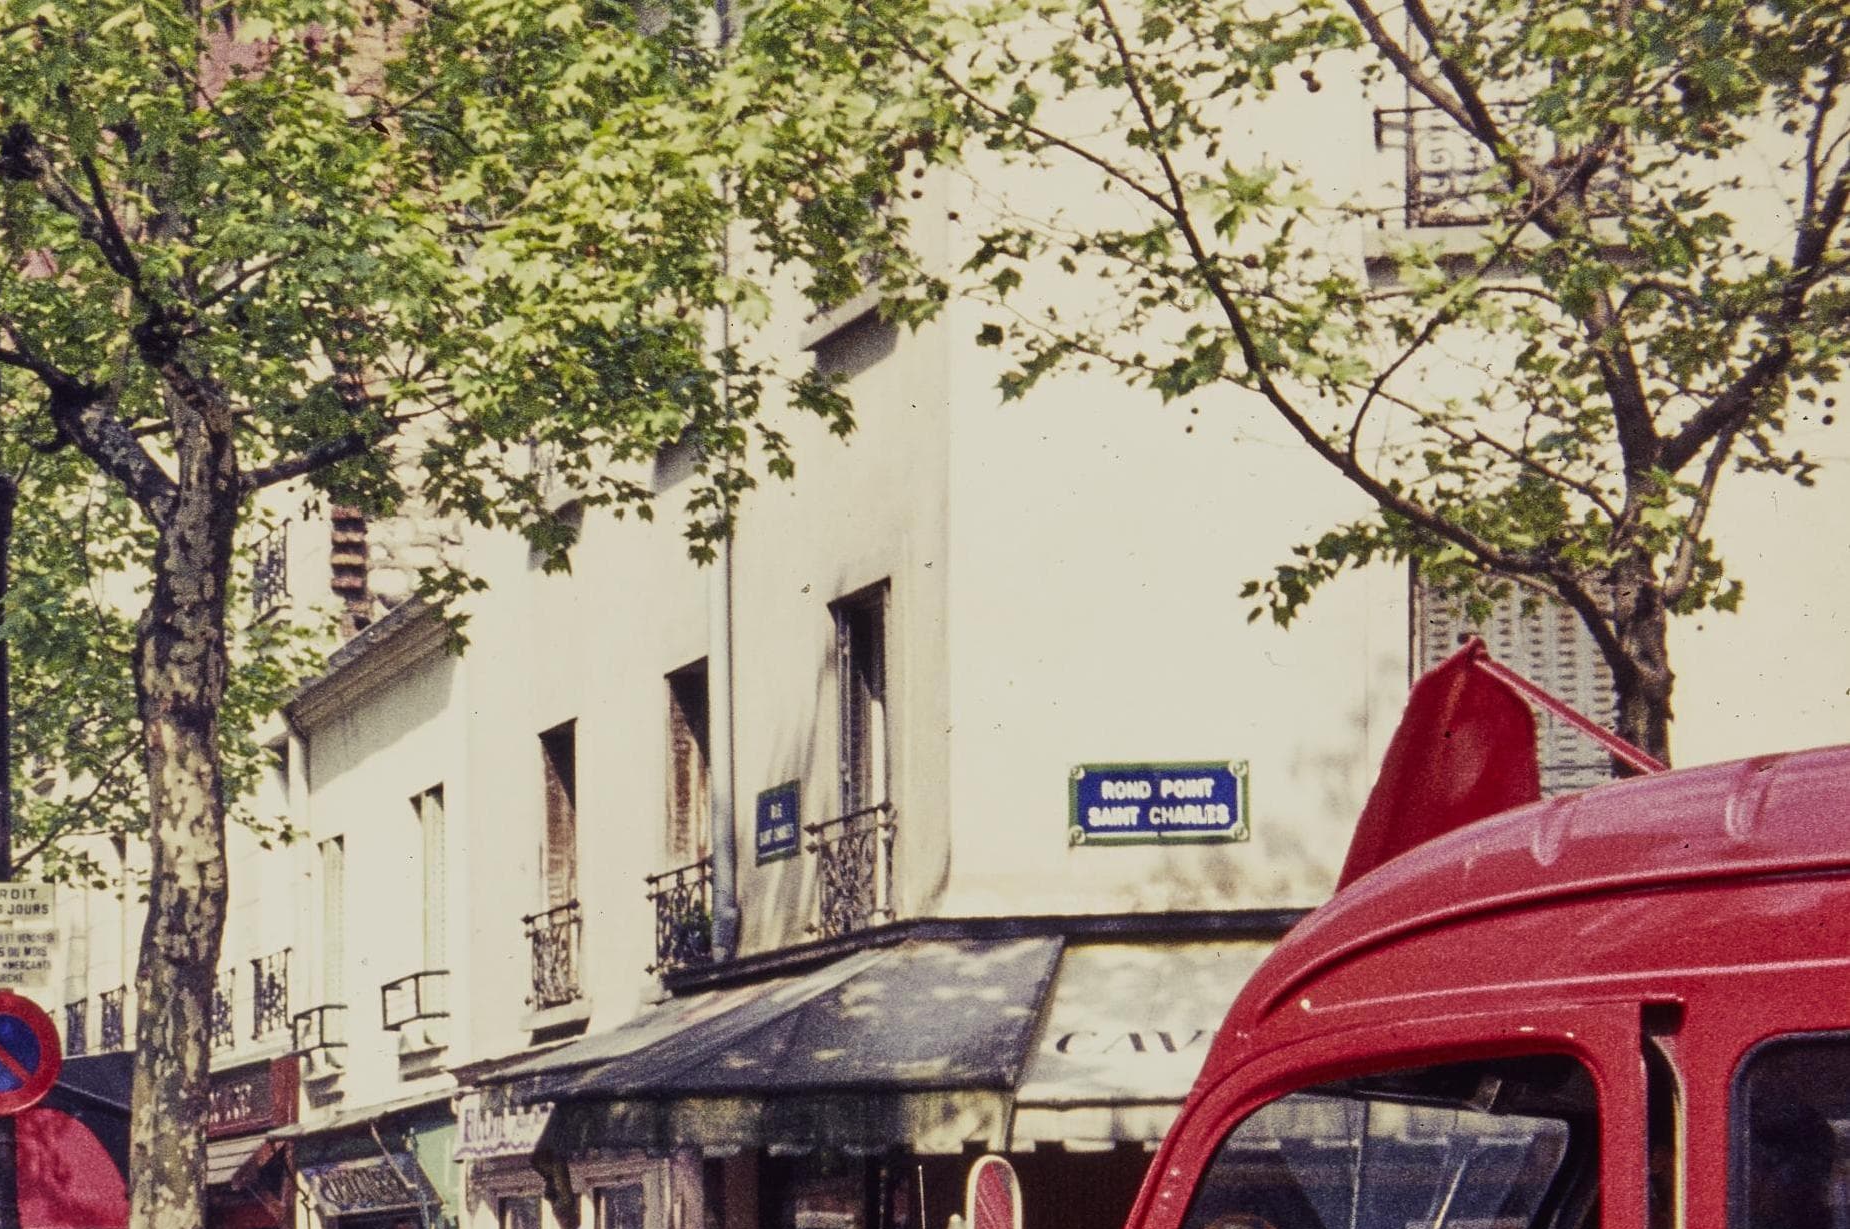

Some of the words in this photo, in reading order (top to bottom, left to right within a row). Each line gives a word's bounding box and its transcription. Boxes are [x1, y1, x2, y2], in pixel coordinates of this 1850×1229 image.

[1101, 780, 1151, 800] ROND
[1160, 778, 1215, 798] POINT
[1088, 806, 1140, 826] SAINT
[1149, 803, 1230, 825] CHARLES
[7, 904, 49, 915] JOURS
